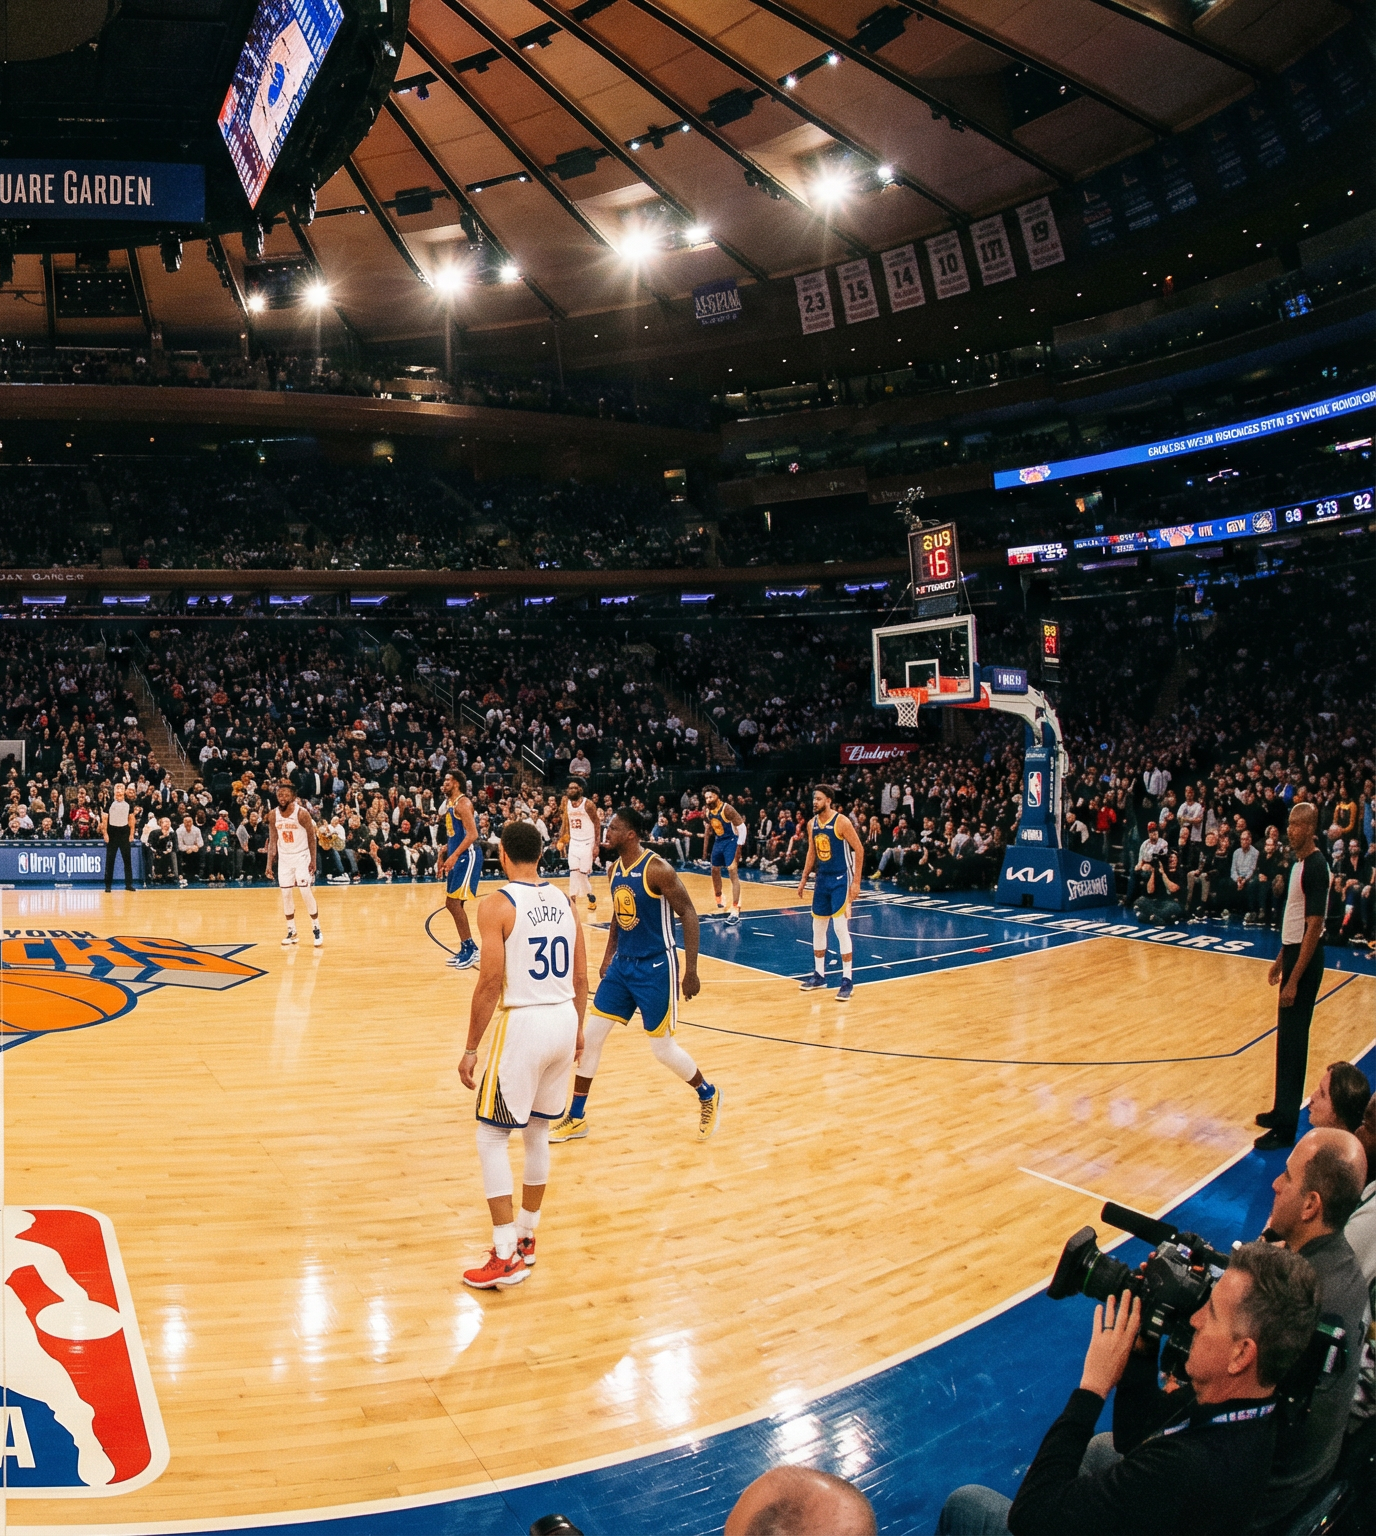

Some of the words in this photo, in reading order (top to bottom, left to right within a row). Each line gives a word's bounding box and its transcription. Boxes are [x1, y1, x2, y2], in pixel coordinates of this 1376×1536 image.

[938, 252, 959, 277] 10
[893, 266, 914, 289] 14
[803, 291, 825, 314] 23
[846, 280, 869, 302] 15
[1353, 493, 1372, 511] 92
[528, 935, 569, 980] 30
